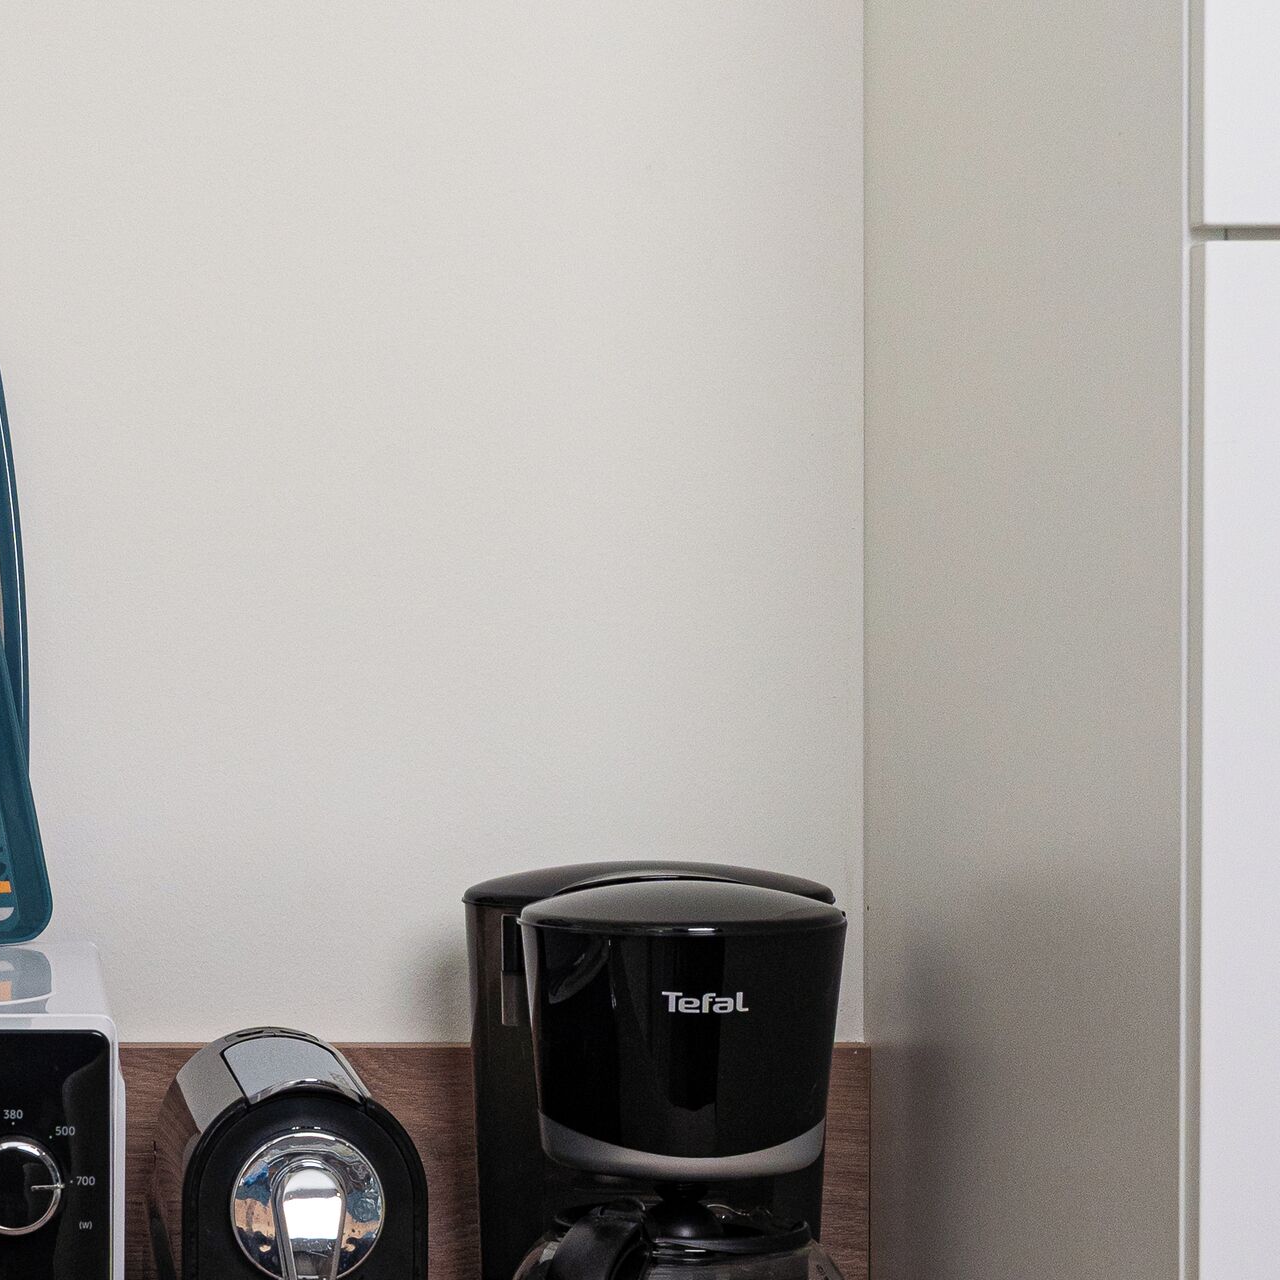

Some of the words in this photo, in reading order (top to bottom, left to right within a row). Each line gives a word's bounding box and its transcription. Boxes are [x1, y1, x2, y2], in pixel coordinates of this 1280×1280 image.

[661, 991, 749, 1014] Tefal
[3, 1109, 24, 1119] 380
[55, 1126, 75, 1136] 500
[76, 1176, 96, 1186] 700
[78, 1221, 93, 1230] (W)
